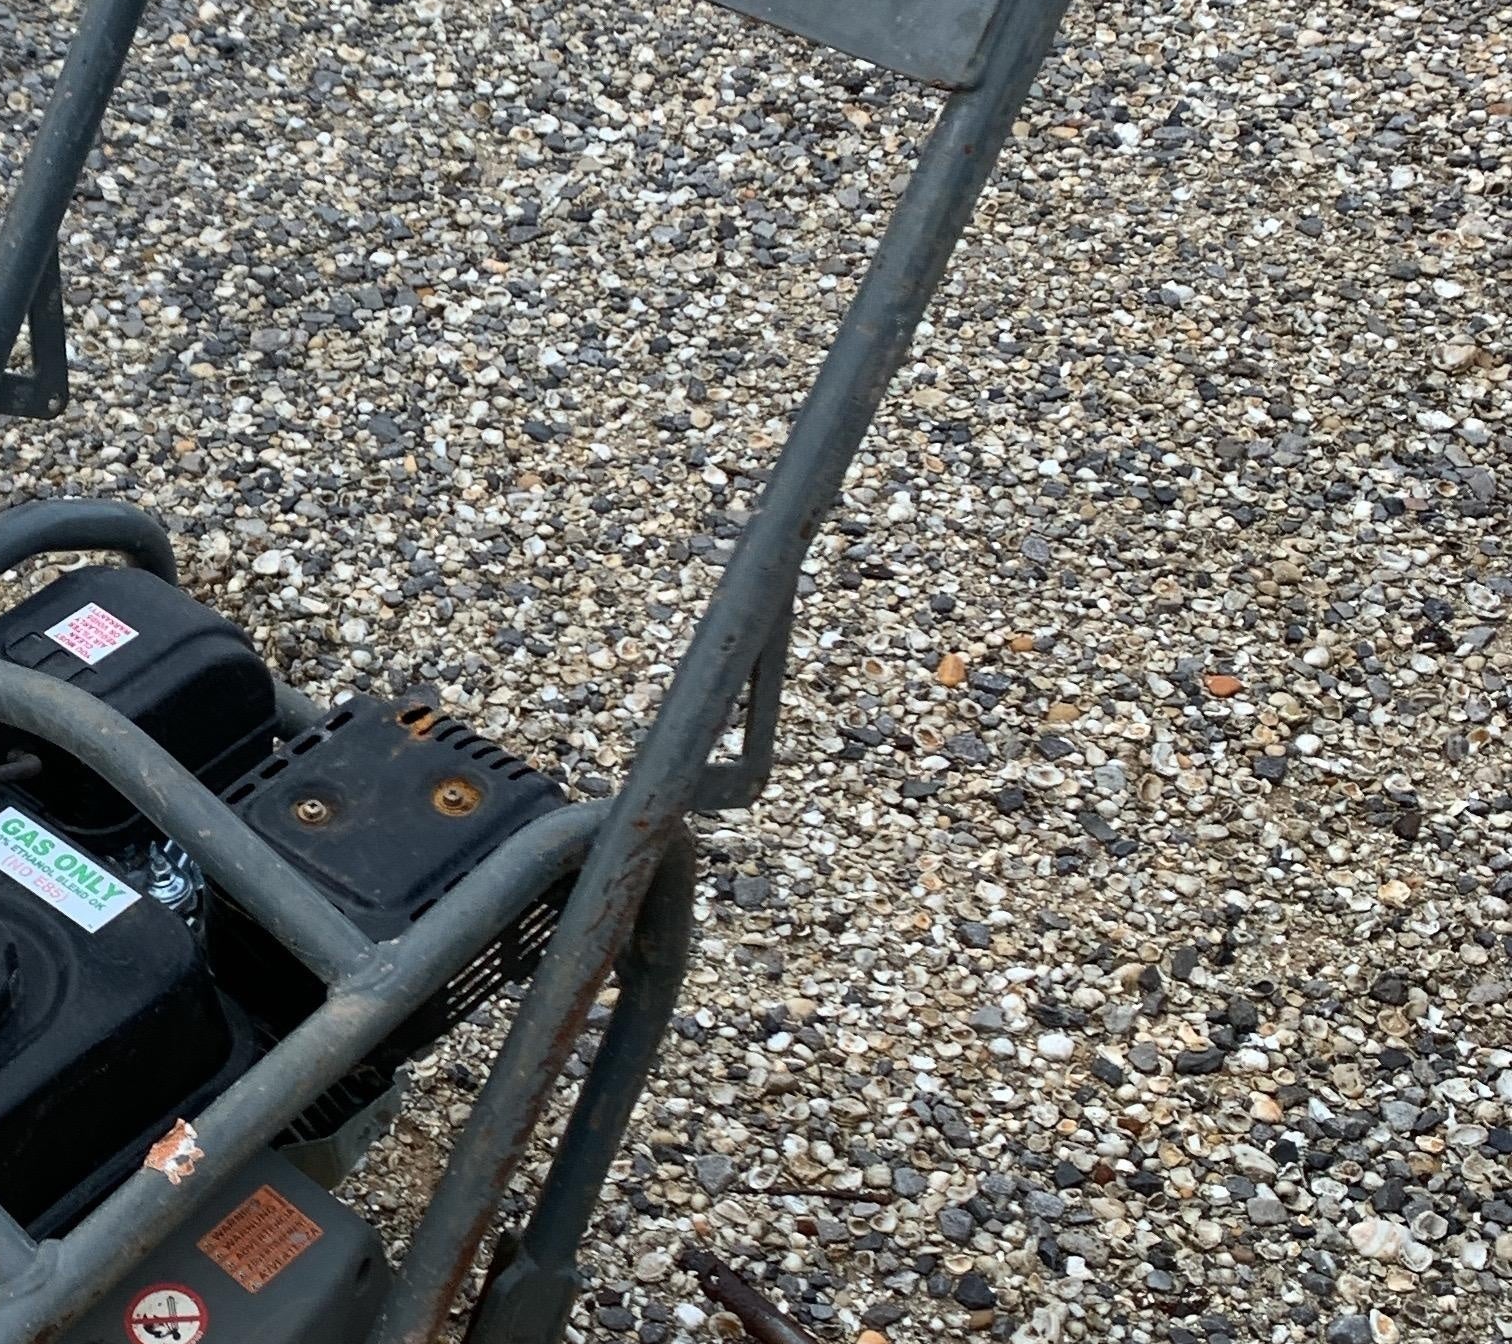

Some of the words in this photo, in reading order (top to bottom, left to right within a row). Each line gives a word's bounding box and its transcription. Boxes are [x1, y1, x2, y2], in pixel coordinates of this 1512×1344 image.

[1, 818, 55, 856] GAS
[54, 854, 125, 901] ONLY
[10, 844, 54, 877] ETHANOL
[55, 875, 88, 900] BLEND
[88, 897, 107, 911] OK
[34, 875, 69, 902] E85)
